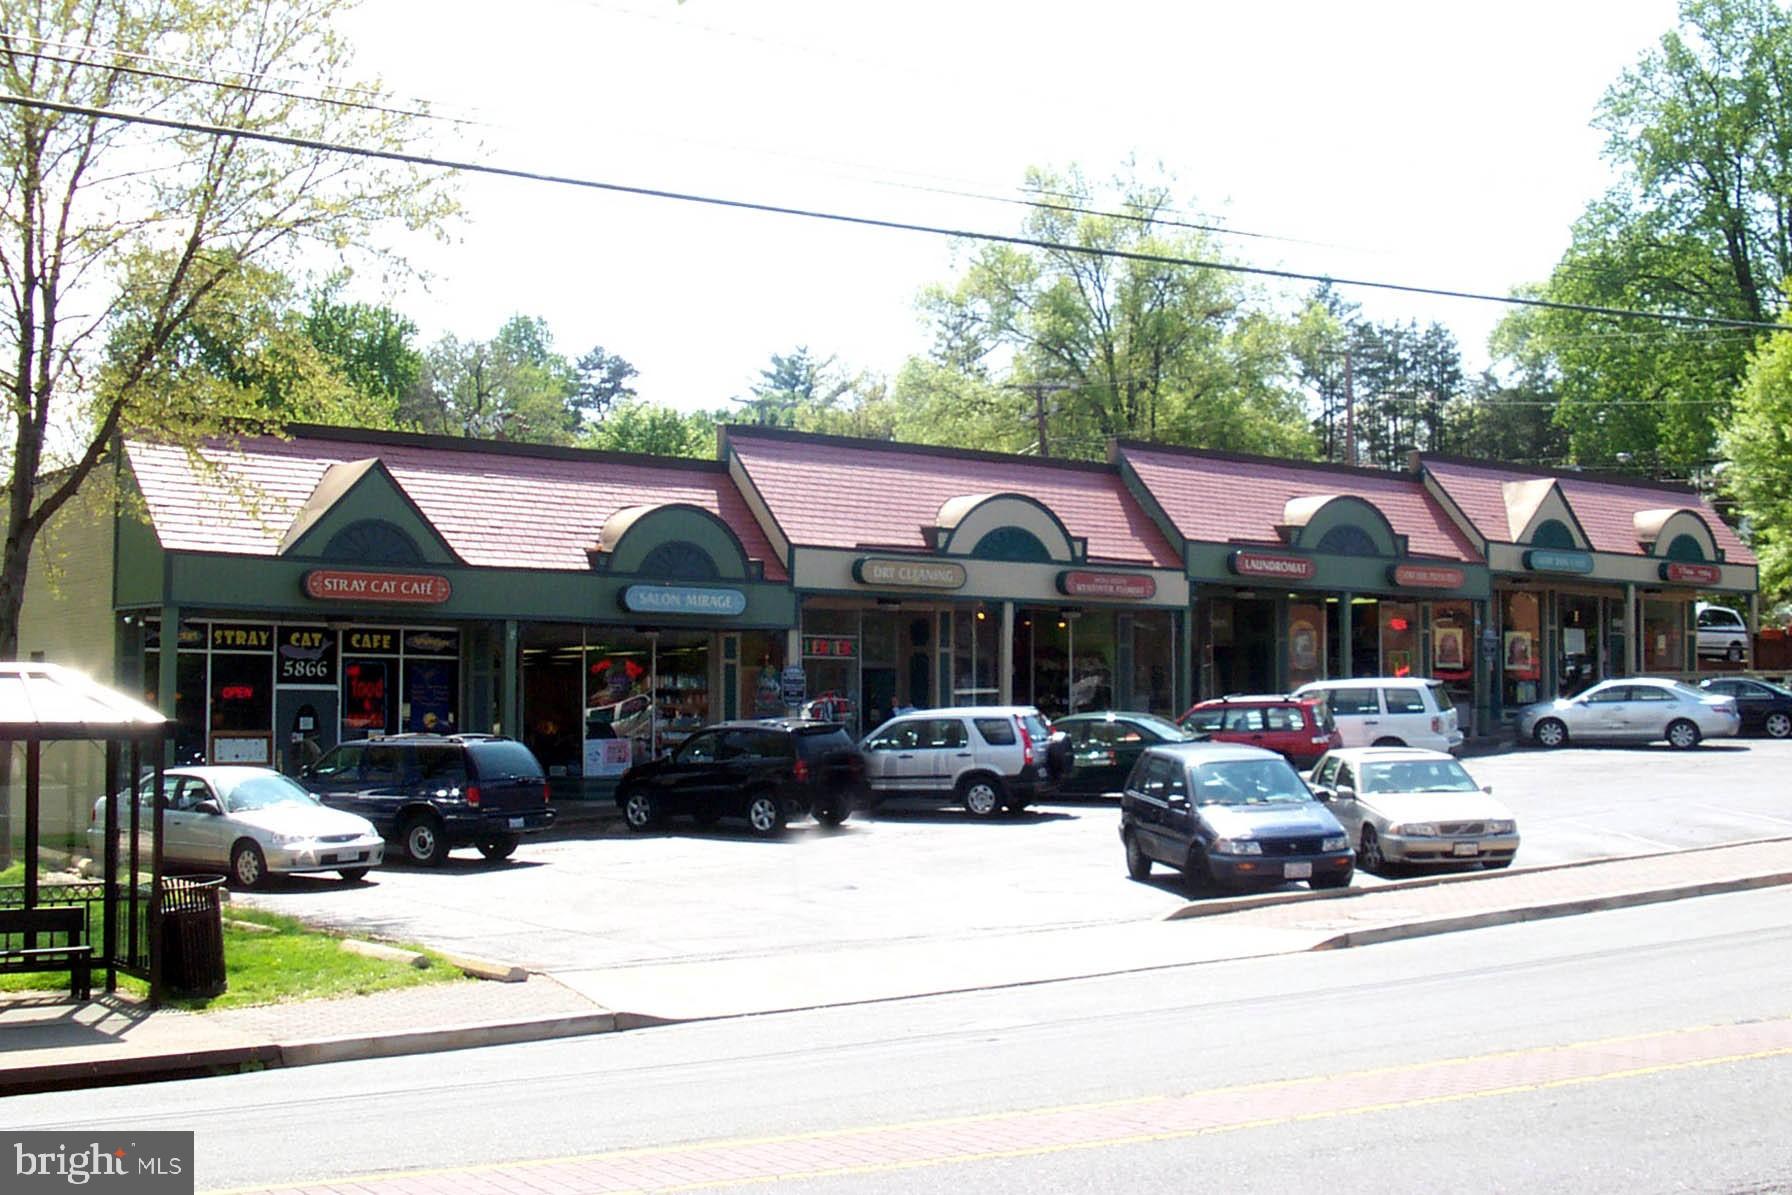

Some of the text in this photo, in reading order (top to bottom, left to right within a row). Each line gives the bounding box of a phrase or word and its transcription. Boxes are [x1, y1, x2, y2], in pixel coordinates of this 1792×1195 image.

[873, 565, 954, 582] DRY CLEANING
[1244, 559, 1307, 574] LAUNDROMAT
[323, 578, 367, 592] STRAY
[370, 580, 397, 593] CAT
[639, 592, 735, 609] SALON MIRAGE
[213, 629, 269, 646] STRAY
[290, 631, 323, 647] CAT
[351, 633, 392, 649] CAFE
[800, 639, 859, 656] LEANERS
[281, 660, 328, 677] 5866
[222, 686, 254, 699] OPEN
